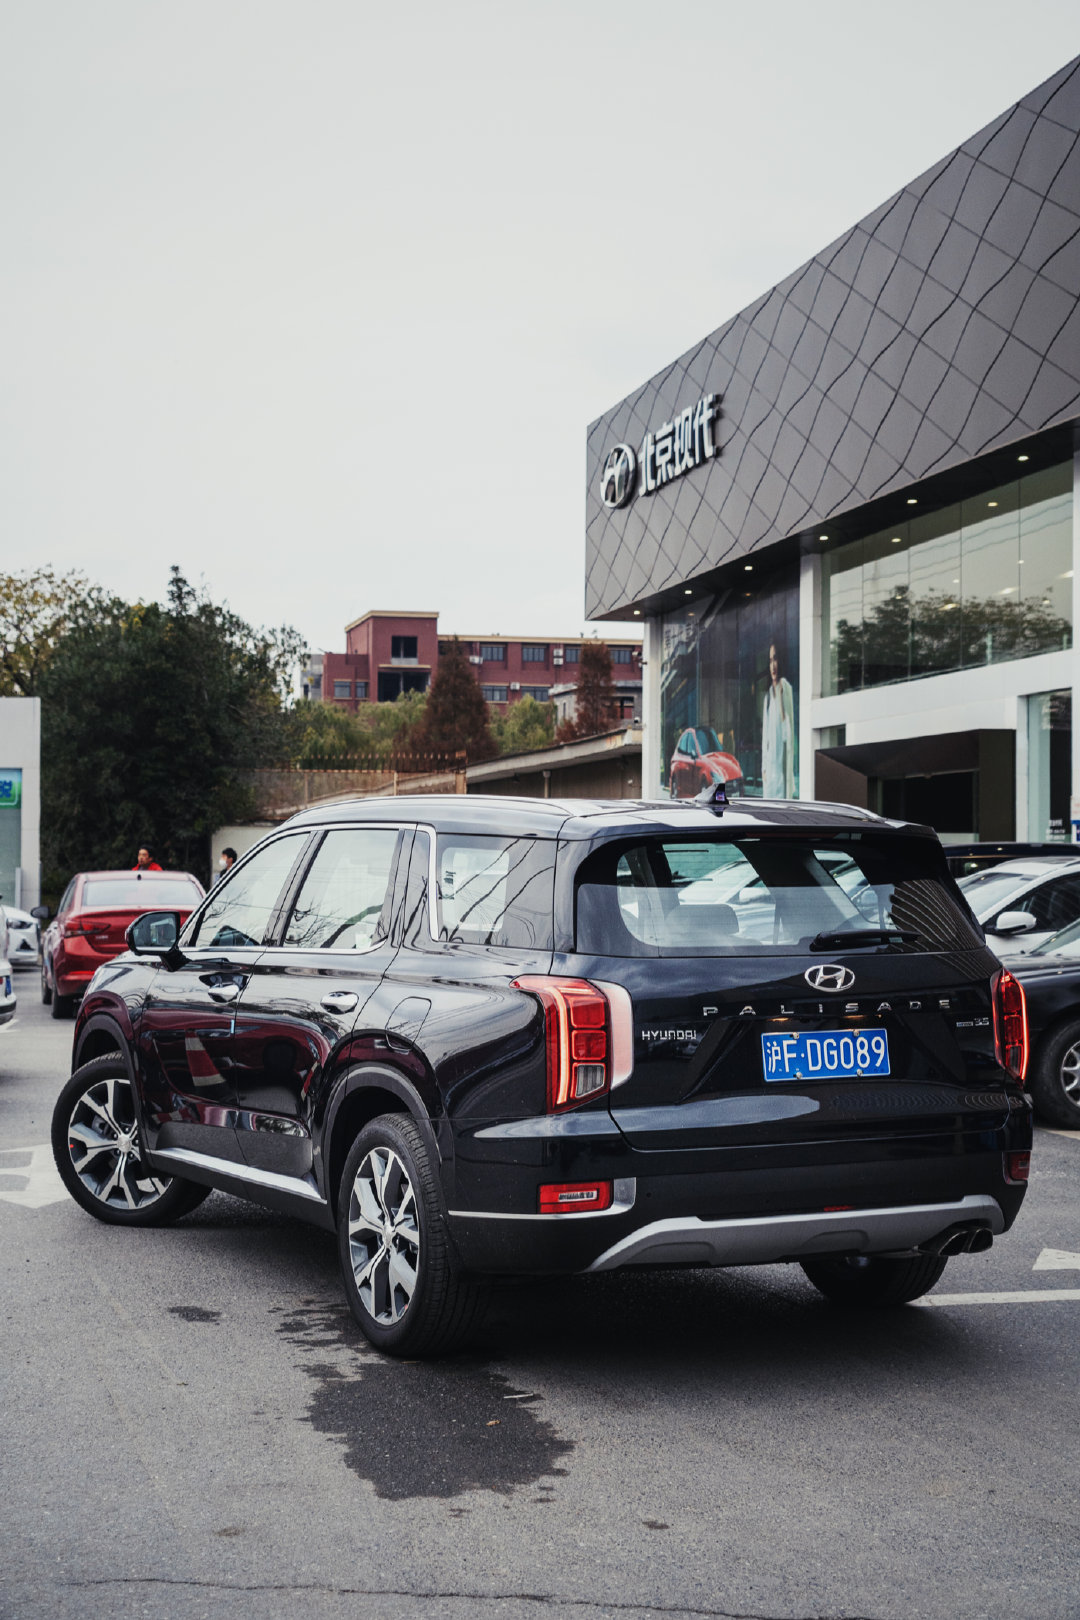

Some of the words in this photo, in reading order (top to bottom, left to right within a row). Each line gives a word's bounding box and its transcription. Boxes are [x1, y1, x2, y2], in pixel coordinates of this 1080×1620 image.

[638, 394, 718, 497] 北京现代
[702, 999, 950, 1017] PALISADE
[641, 1029, 697, 1041] HYUNDAI
